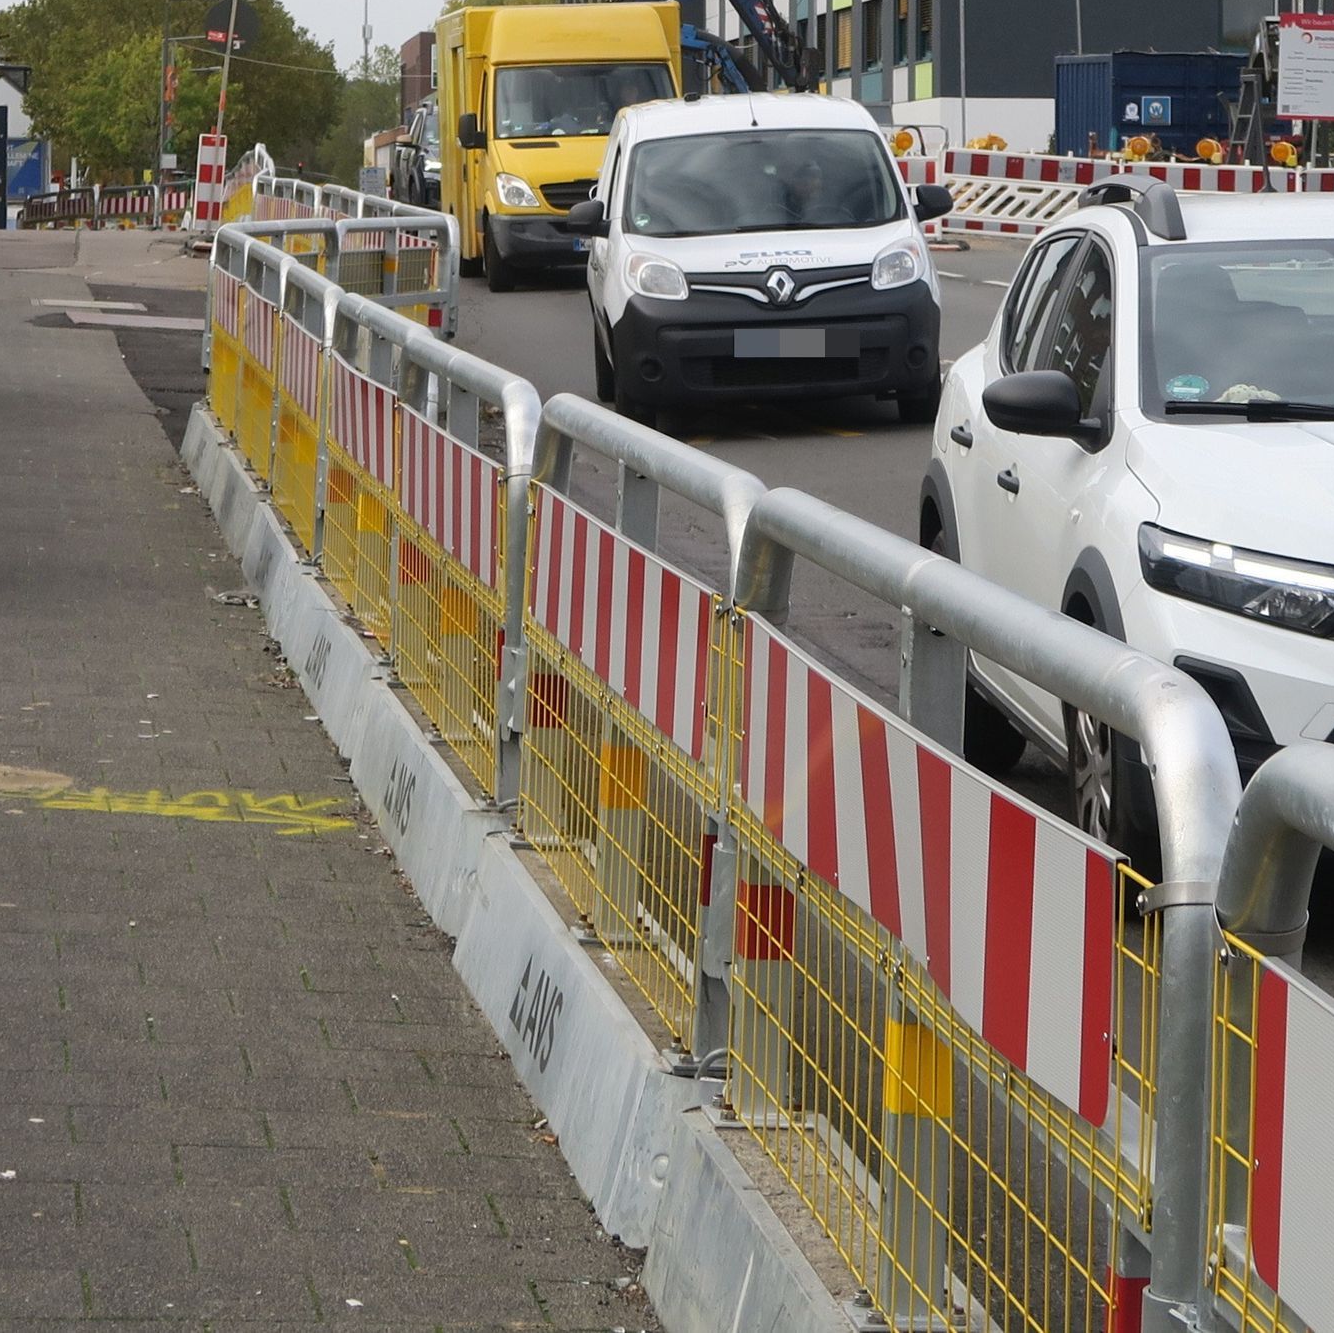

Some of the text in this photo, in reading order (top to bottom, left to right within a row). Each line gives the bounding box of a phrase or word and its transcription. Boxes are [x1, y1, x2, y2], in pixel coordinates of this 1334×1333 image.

[725, 257, 834, 268] PV AUTOMOTIVE
[391, 762, 416, 837] AVS
[523, 968, 564, 1074] AVS
